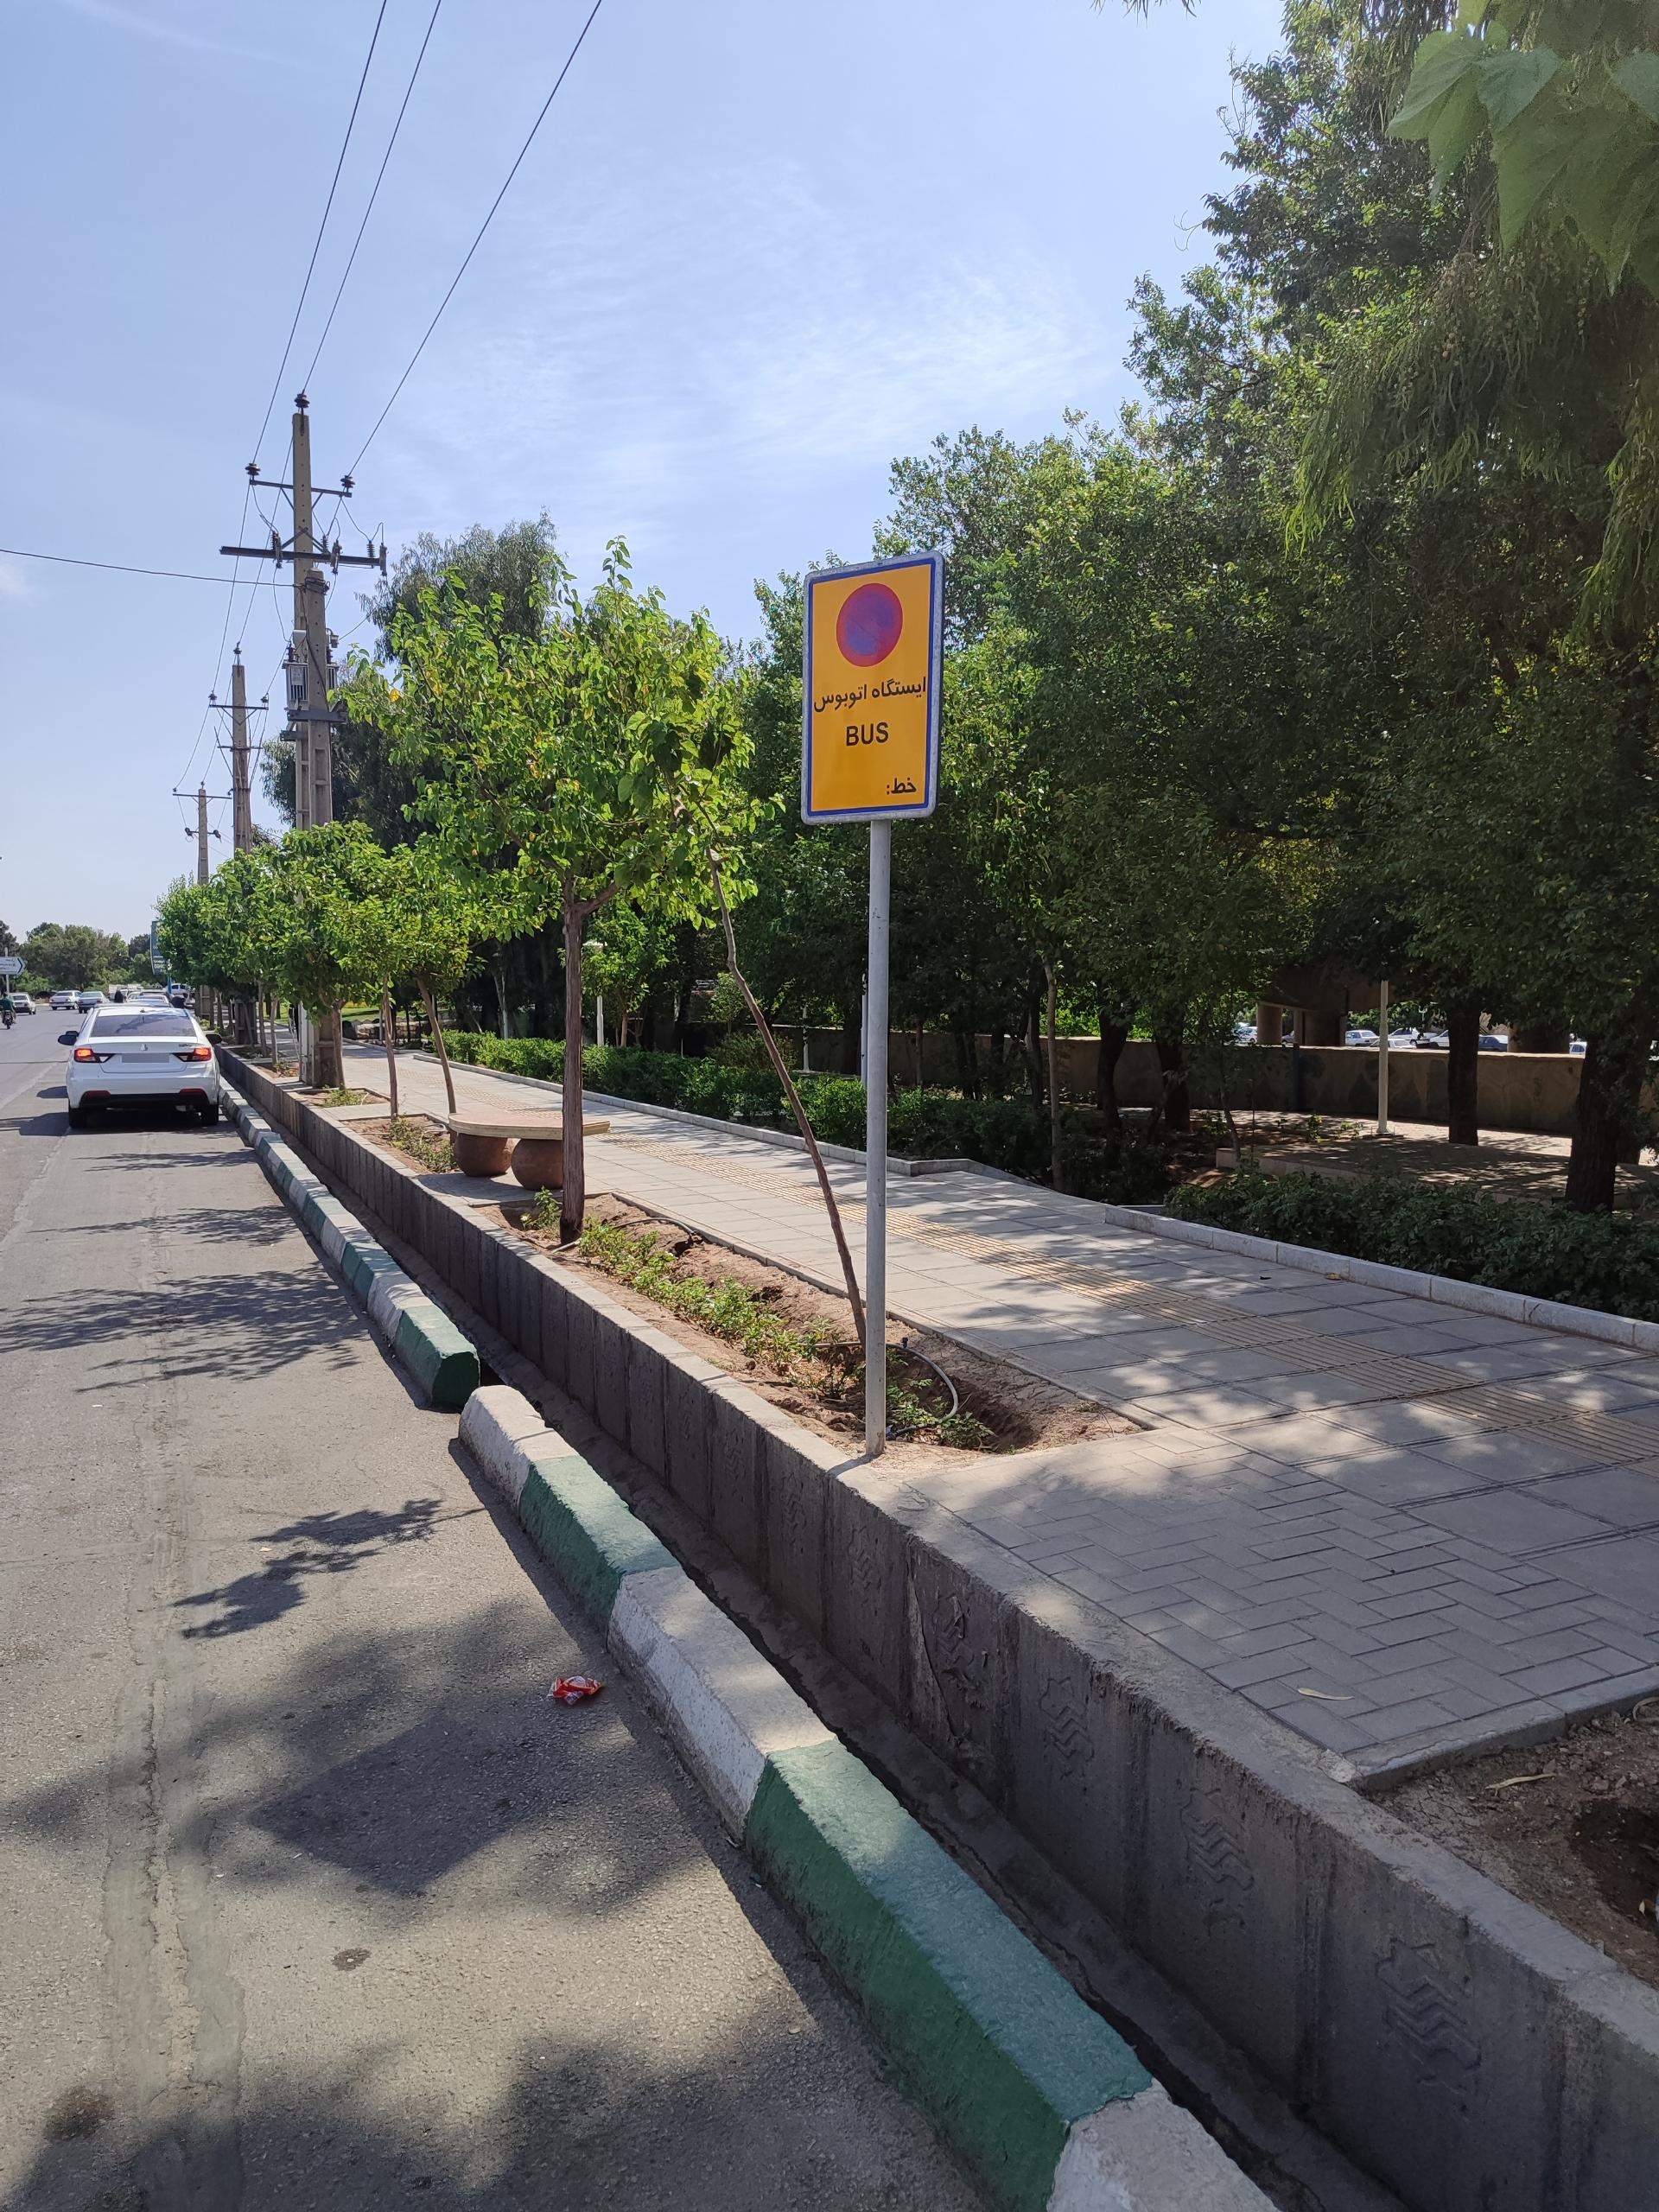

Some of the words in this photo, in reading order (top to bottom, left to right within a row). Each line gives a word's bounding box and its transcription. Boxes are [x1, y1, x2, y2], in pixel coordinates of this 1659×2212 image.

[814, 684, 868, 712] اتوبوس
[872, 677, 926, 699] ایستگاه
[845, 721, 889, 747] BUS
